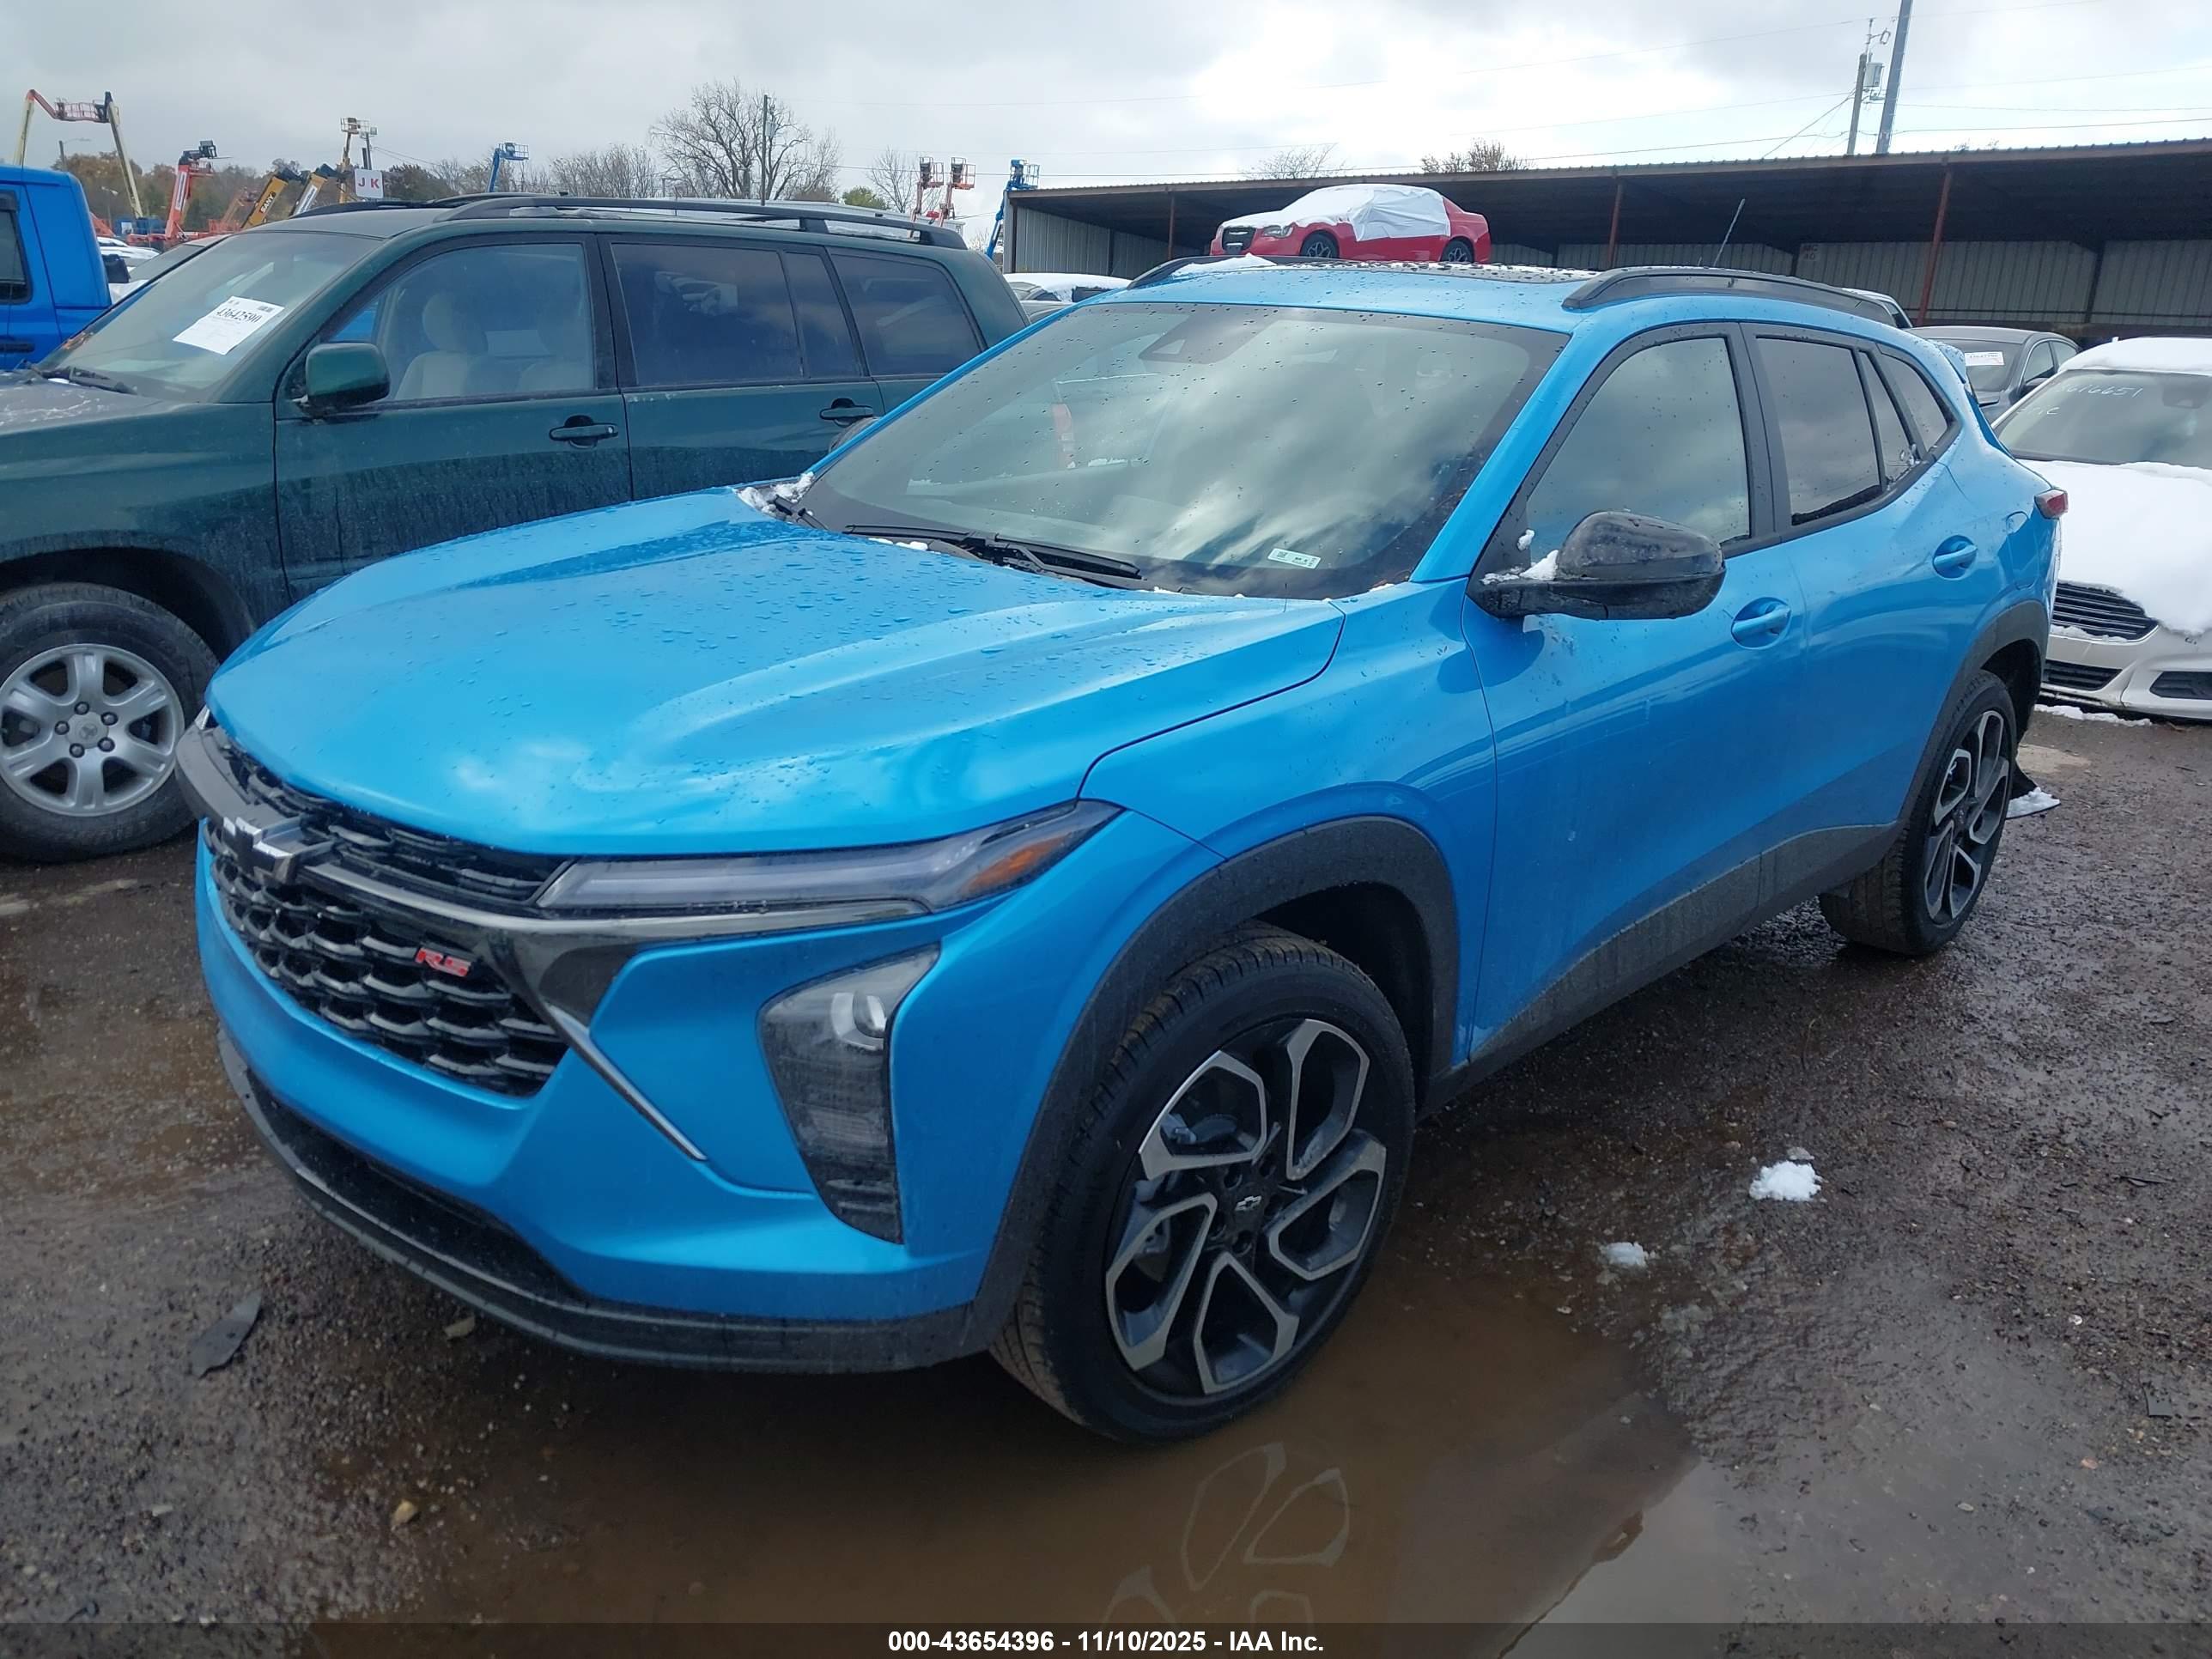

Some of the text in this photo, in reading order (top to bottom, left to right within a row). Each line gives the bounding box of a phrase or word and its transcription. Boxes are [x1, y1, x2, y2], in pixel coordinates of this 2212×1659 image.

[357, 177, 380, 189] J K
[260, 192, 274, 213] SANY
[415, 947, 471, 977] RS
